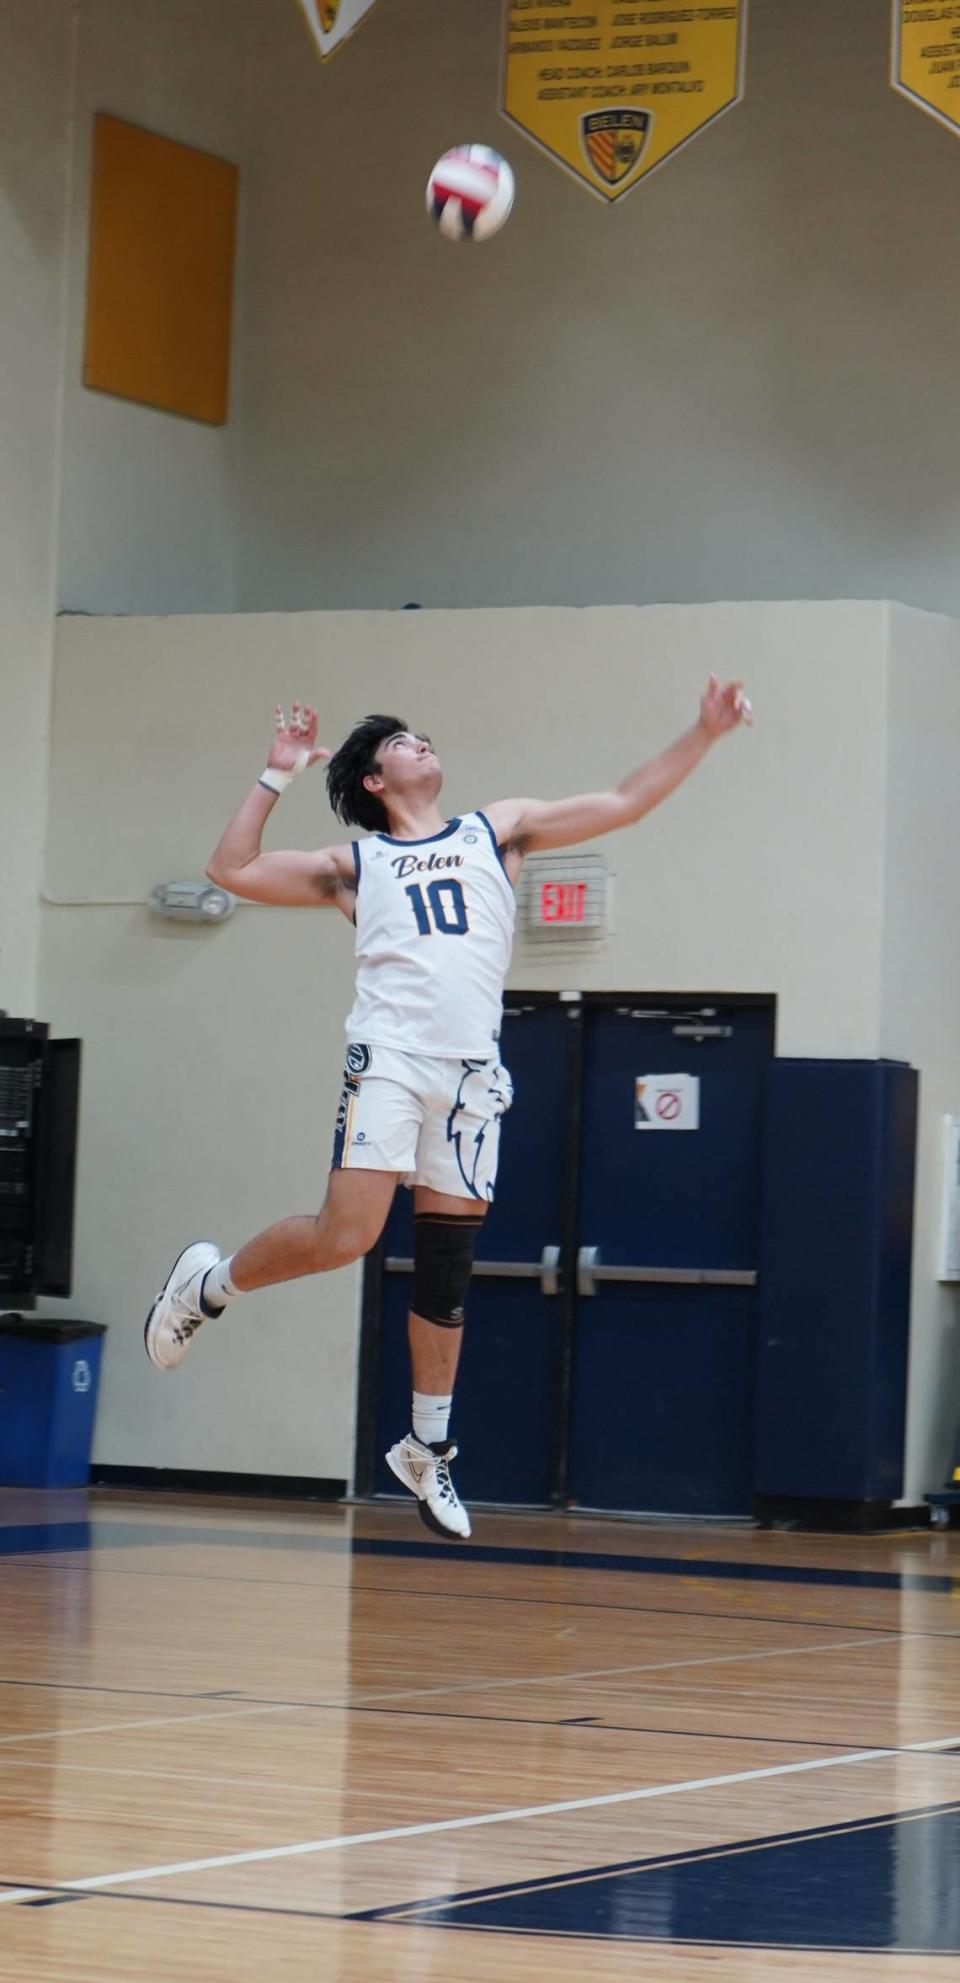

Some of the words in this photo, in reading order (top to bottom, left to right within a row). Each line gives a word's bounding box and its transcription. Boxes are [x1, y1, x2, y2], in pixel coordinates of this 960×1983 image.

[538, 68, 563, 81] HEAD
[537, 87, 588, 101] ASSISTANT
[587, 113, 645, 130] BELEN
[391, 853, 465, 879] Belen
[405, 878, 470, 936] 10
[542, 884, 586, 922] EXIT
